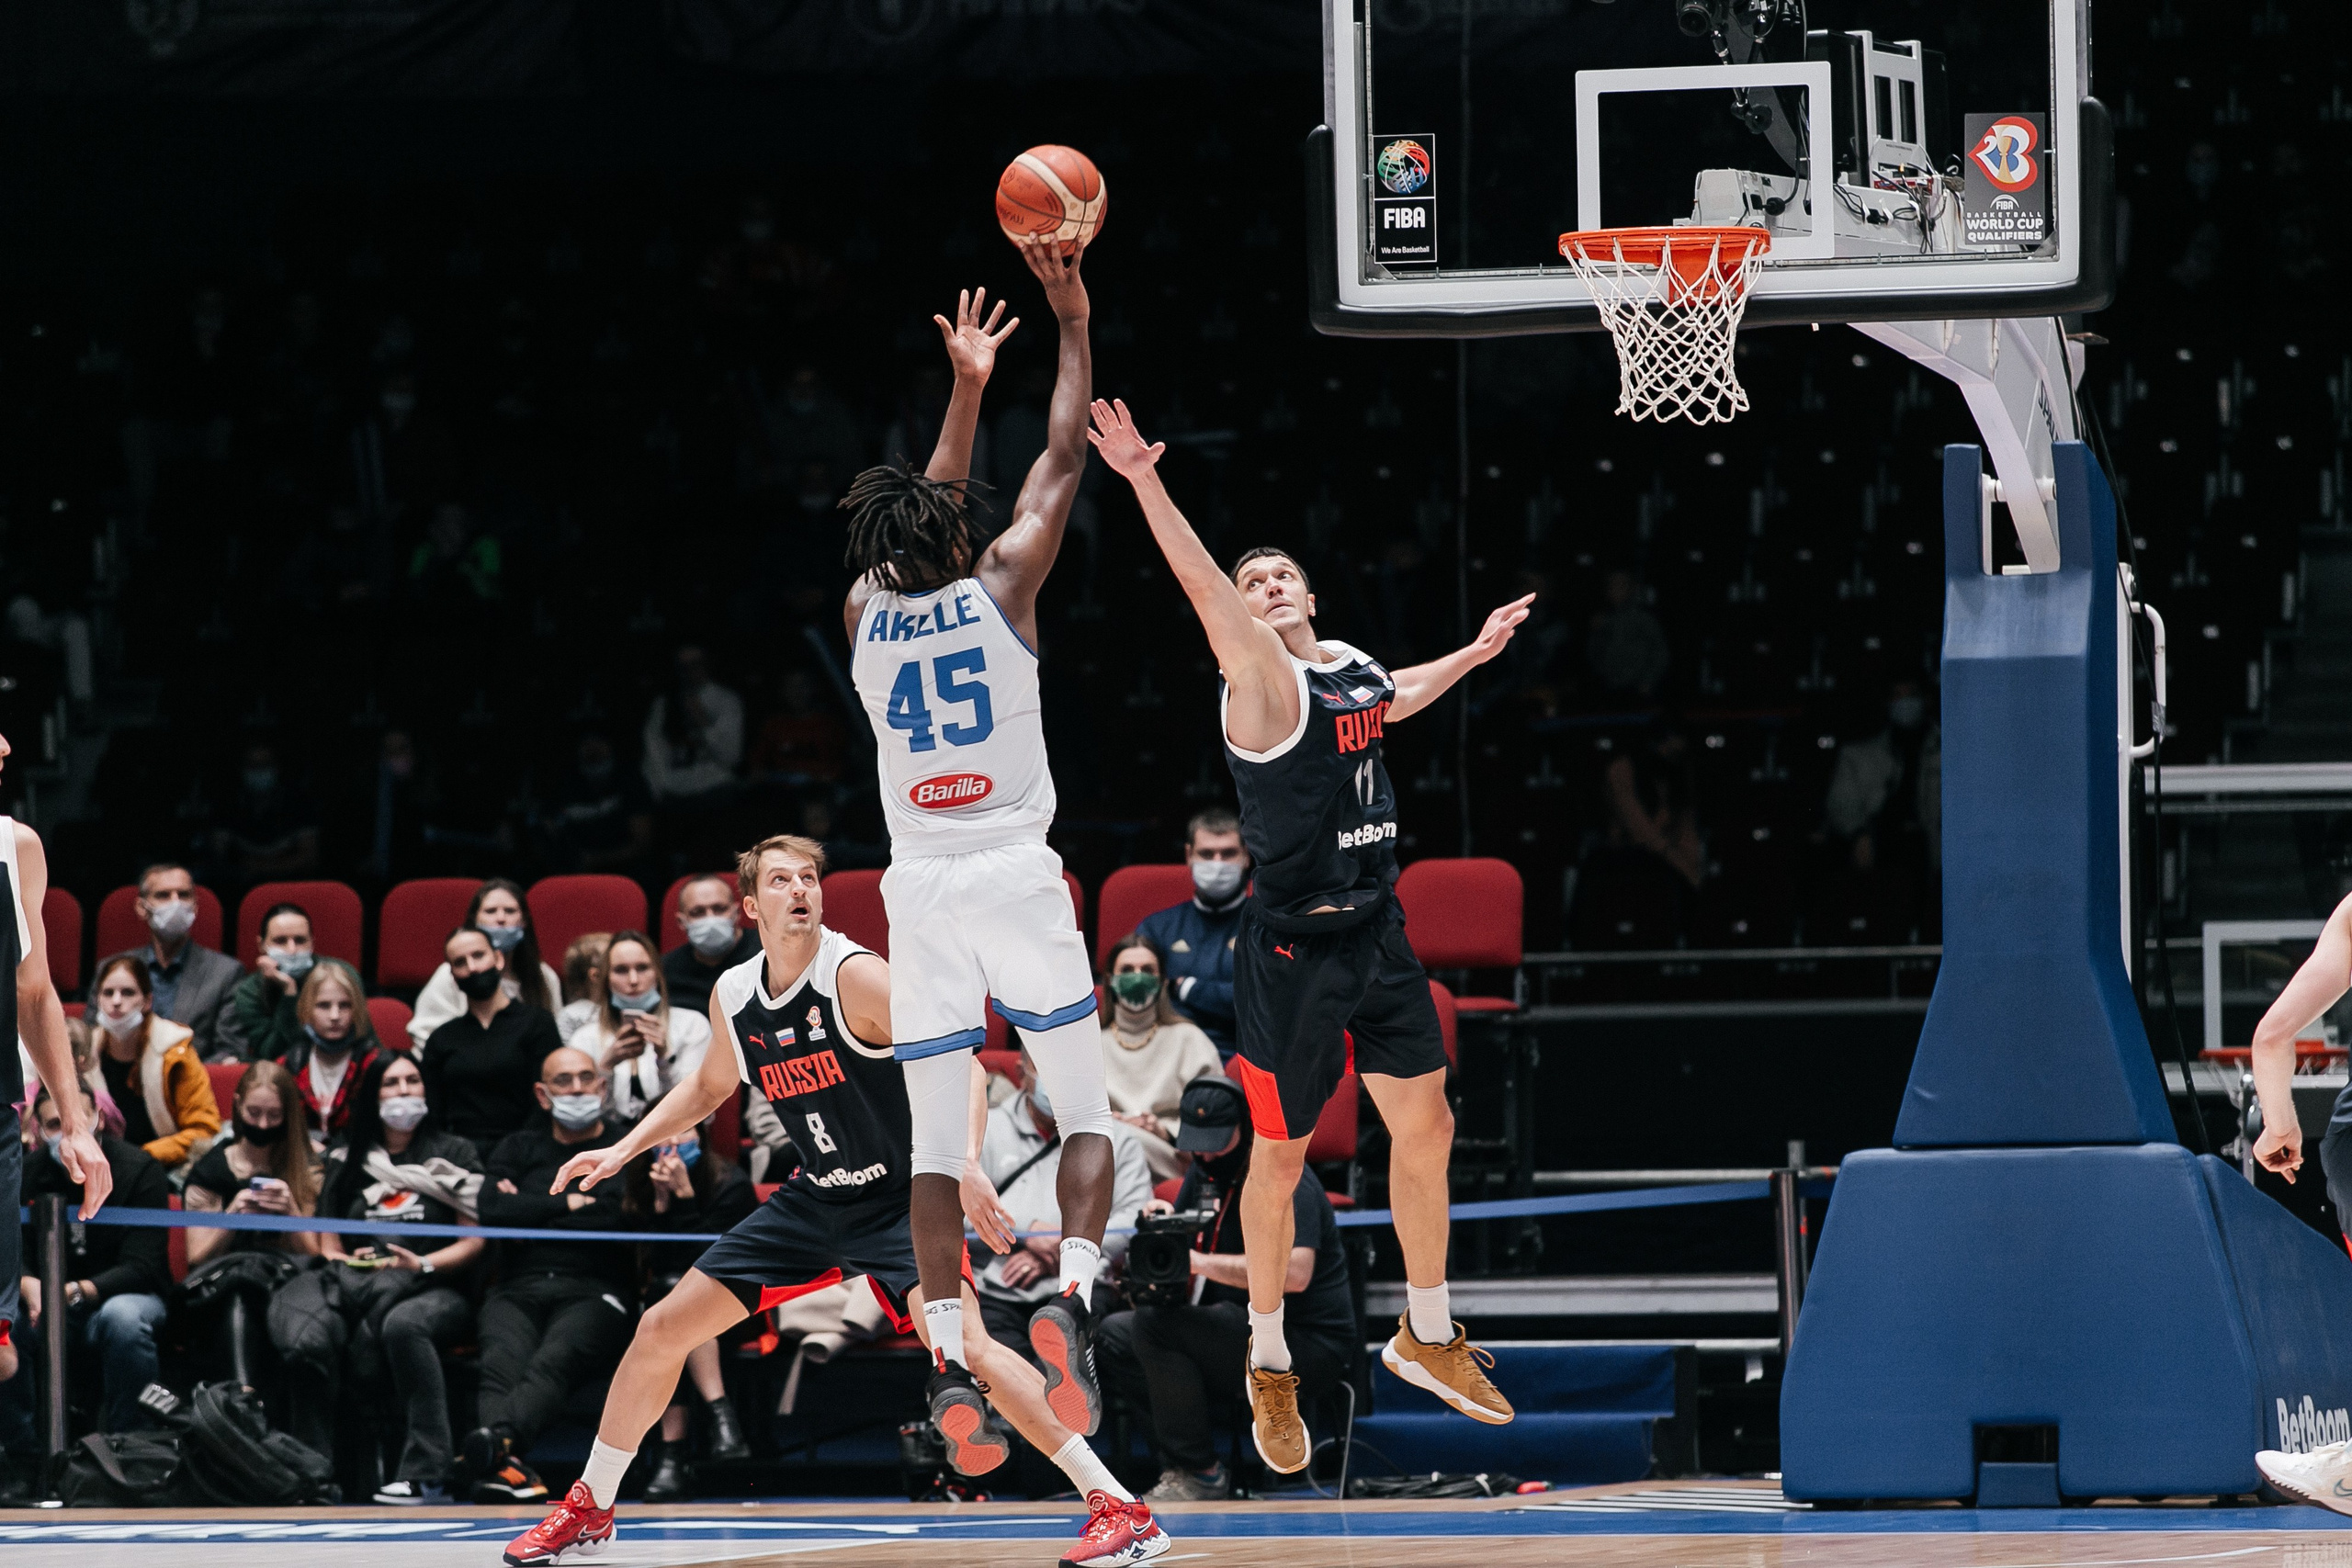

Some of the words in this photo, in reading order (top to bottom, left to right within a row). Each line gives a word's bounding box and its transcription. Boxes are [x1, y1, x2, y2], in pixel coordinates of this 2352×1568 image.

[1384, 207, 1426, 229] FIBA
[1996, 201, 2014, 210] FIBA
[1966, 219, 2015, 230] WORLD
[2017, 218, 2043, 230] CUP
[1402, 245, 1430, 254] Basketball
[1967, 231, 2042, 243] QUALIFIERS
[887, 646, 994, 753] 45
[917, 776, 987, 804] Barilla
[759, 1049, 846, 1101] RUSSIA
[806, 1112, 837, 1154] 8
[2276, 1395, 2350, 1453] BetBoom
